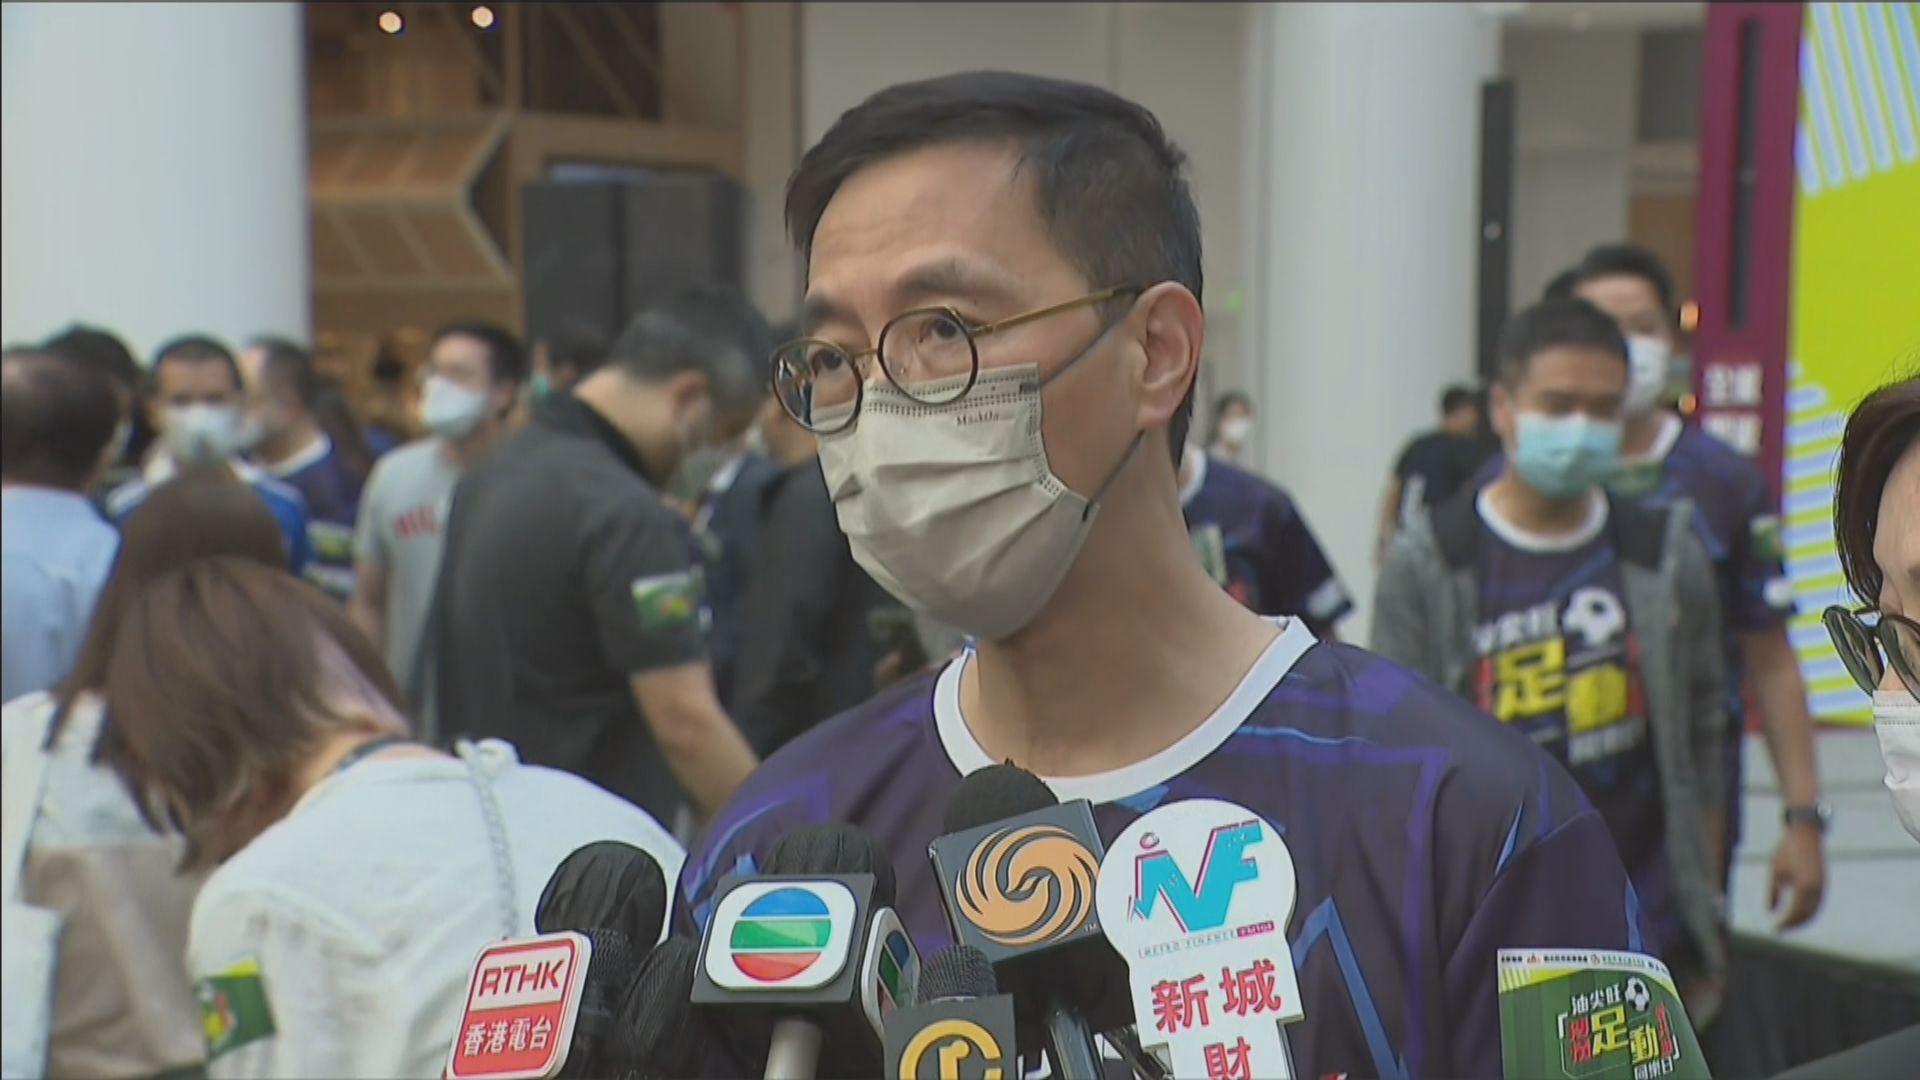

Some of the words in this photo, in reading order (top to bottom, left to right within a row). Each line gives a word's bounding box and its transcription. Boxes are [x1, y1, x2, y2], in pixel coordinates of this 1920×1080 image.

[478, 959, 564, 997] RTHK
[1151, 958, 1282, 1034] 新城
[1571, 982, 1622, 1016] 油尖旺
[463, 1016, 553, 1057] 香港電台
[1203, 1036, 1252, 1080] 財
